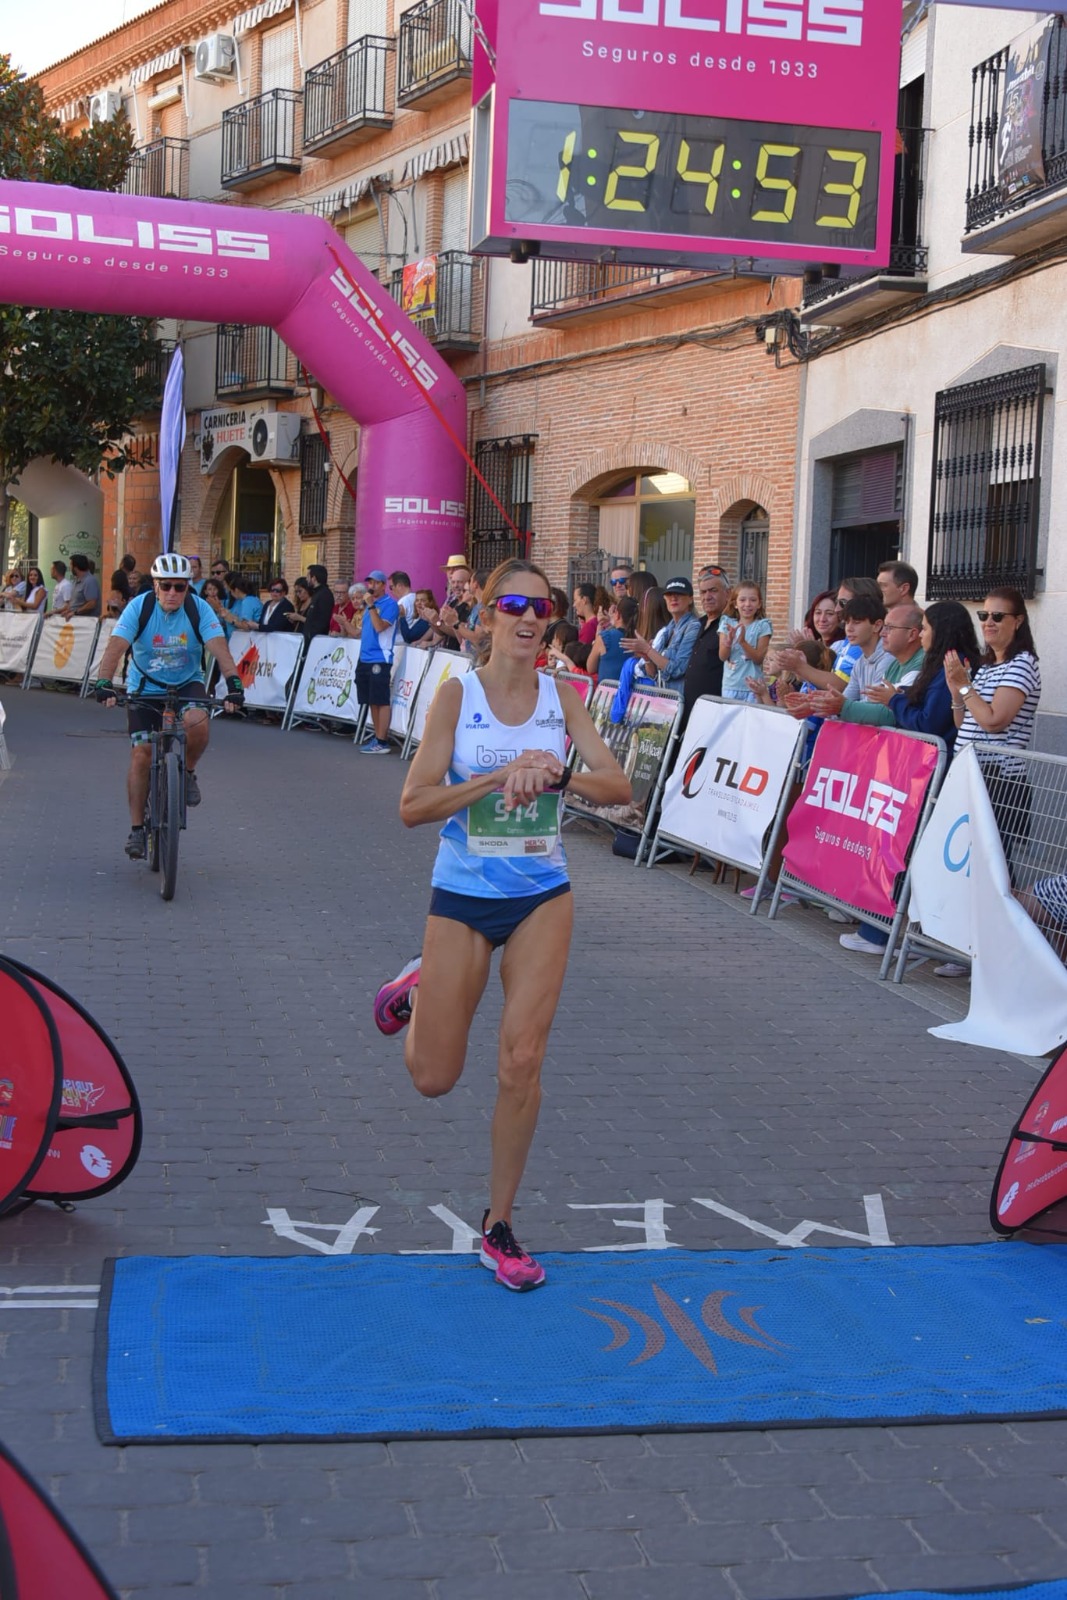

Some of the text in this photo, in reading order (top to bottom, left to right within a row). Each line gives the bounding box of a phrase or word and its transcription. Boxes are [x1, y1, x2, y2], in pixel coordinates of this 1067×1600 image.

[582, 40, 819, 79] Seguros desde 1933
[556, 130, 867, 229] 1:24:53
[0, 205, 270, 261] OLISS
[104, 256, 169, 273] desde
[182, 265, 229, 279] 1933
[331, 300, 408, 387] Seguros desde 1933
[203, 410, 247, 430] CARNICERIA
[216, 428, 246, 444] HUETE
[713, 756, 769, 797] TLD
